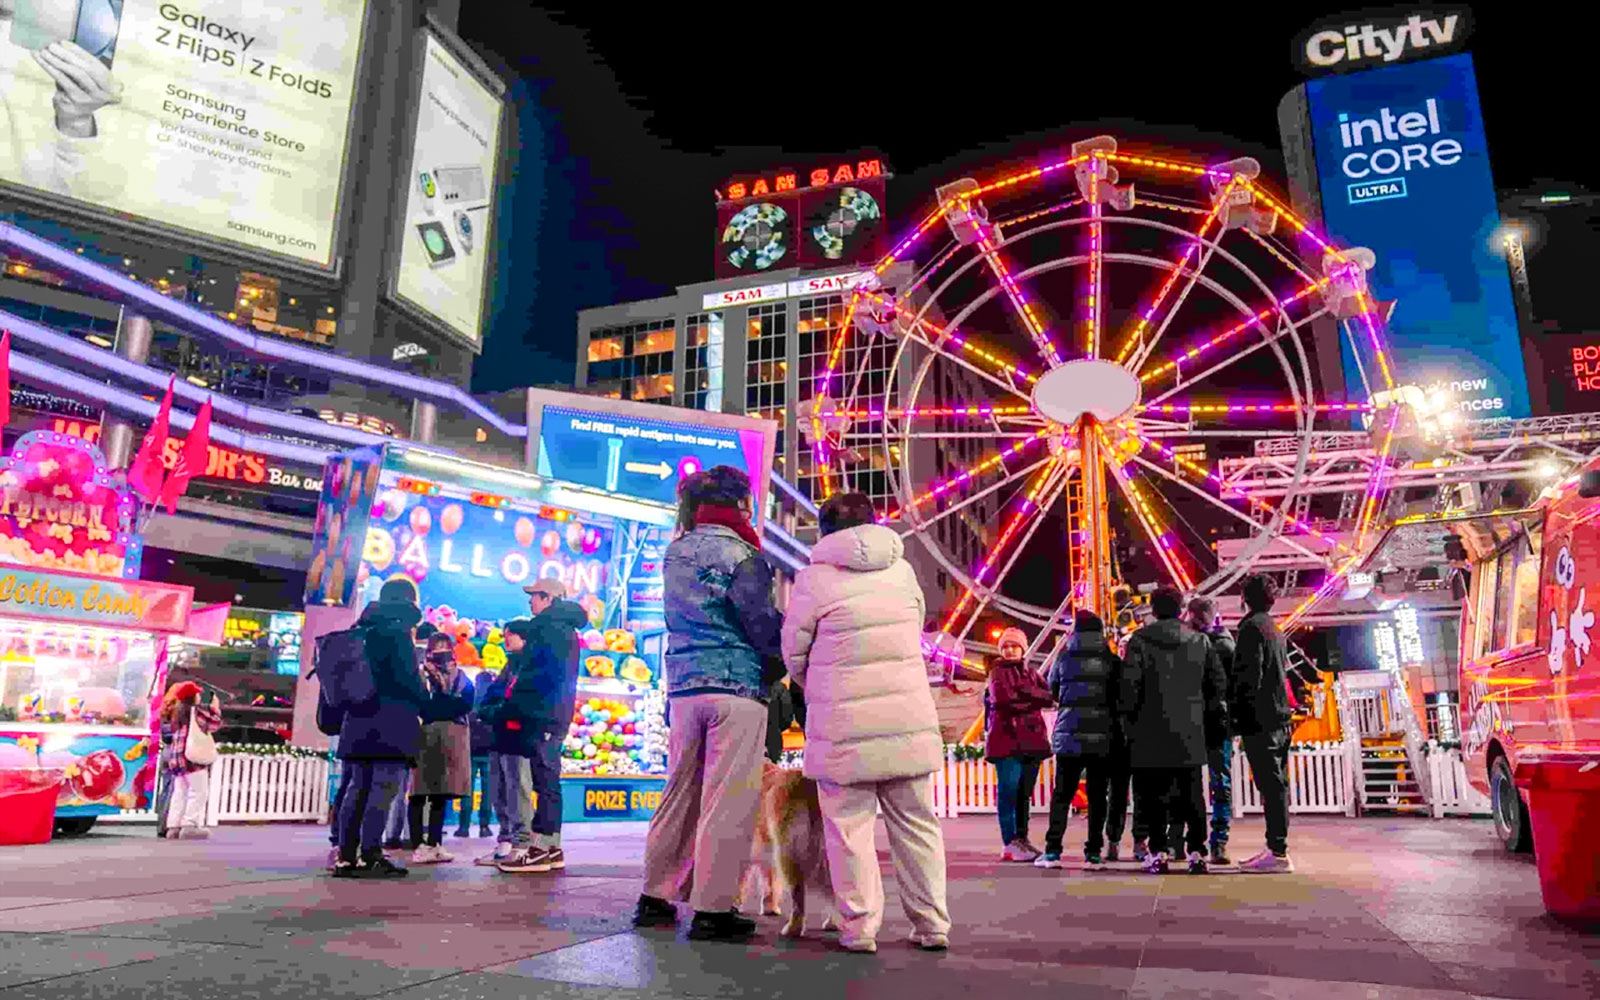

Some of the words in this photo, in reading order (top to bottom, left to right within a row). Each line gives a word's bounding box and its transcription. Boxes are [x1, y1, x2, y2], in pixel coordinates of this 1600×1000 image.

[159, 3, 255, 51] Galaxy
[1306, 14, 1458, 66] Citytv
[155, 26, 171, 46] Z
[176, 33, 236, 67] Flip5
[250, 58, 265, 77] Z
[268, 65, 332, 99] Fold5
[165, 83, 247, 121] Samsung
[159, 118, 216, 146] Yorkdale
[219, 138, 245, 154] Mall
[246, 145, 273, 160] and
[162, 99, 259, 139] Experience
[263, 130, 306, 153] Store
[1338, 98, 1440, 148] intel
[177, 138, 237, 164] Sherway
[238, 156, 292, 179] Gardens
[728, 173, 796, 200] SAM
[810, 159, 882, 187] SAM
[1355, 183, 1399, 198] ULTRA
[227, 220, 317, 251] samsung.com
[723, 288, 762, 304] SAM
[1572, 345, 1600, 361] BO
[1450, 378, 1487, 391] new
[571, 418, 592, 431] Find
[592, 420, 615, 434] FREE
[615, 424, 640, 438] rapid
[640, 428, 674, 442] antigen
[697, 436, 717, 446] near
[267, 467, 300, 488] Bar
[362, 526, 599, 593] BALLOON
[0, 574, 76, 610] Cotton
[81, 583, 149, 620] Candy
[585, 789, 627, 811] PRIZE
